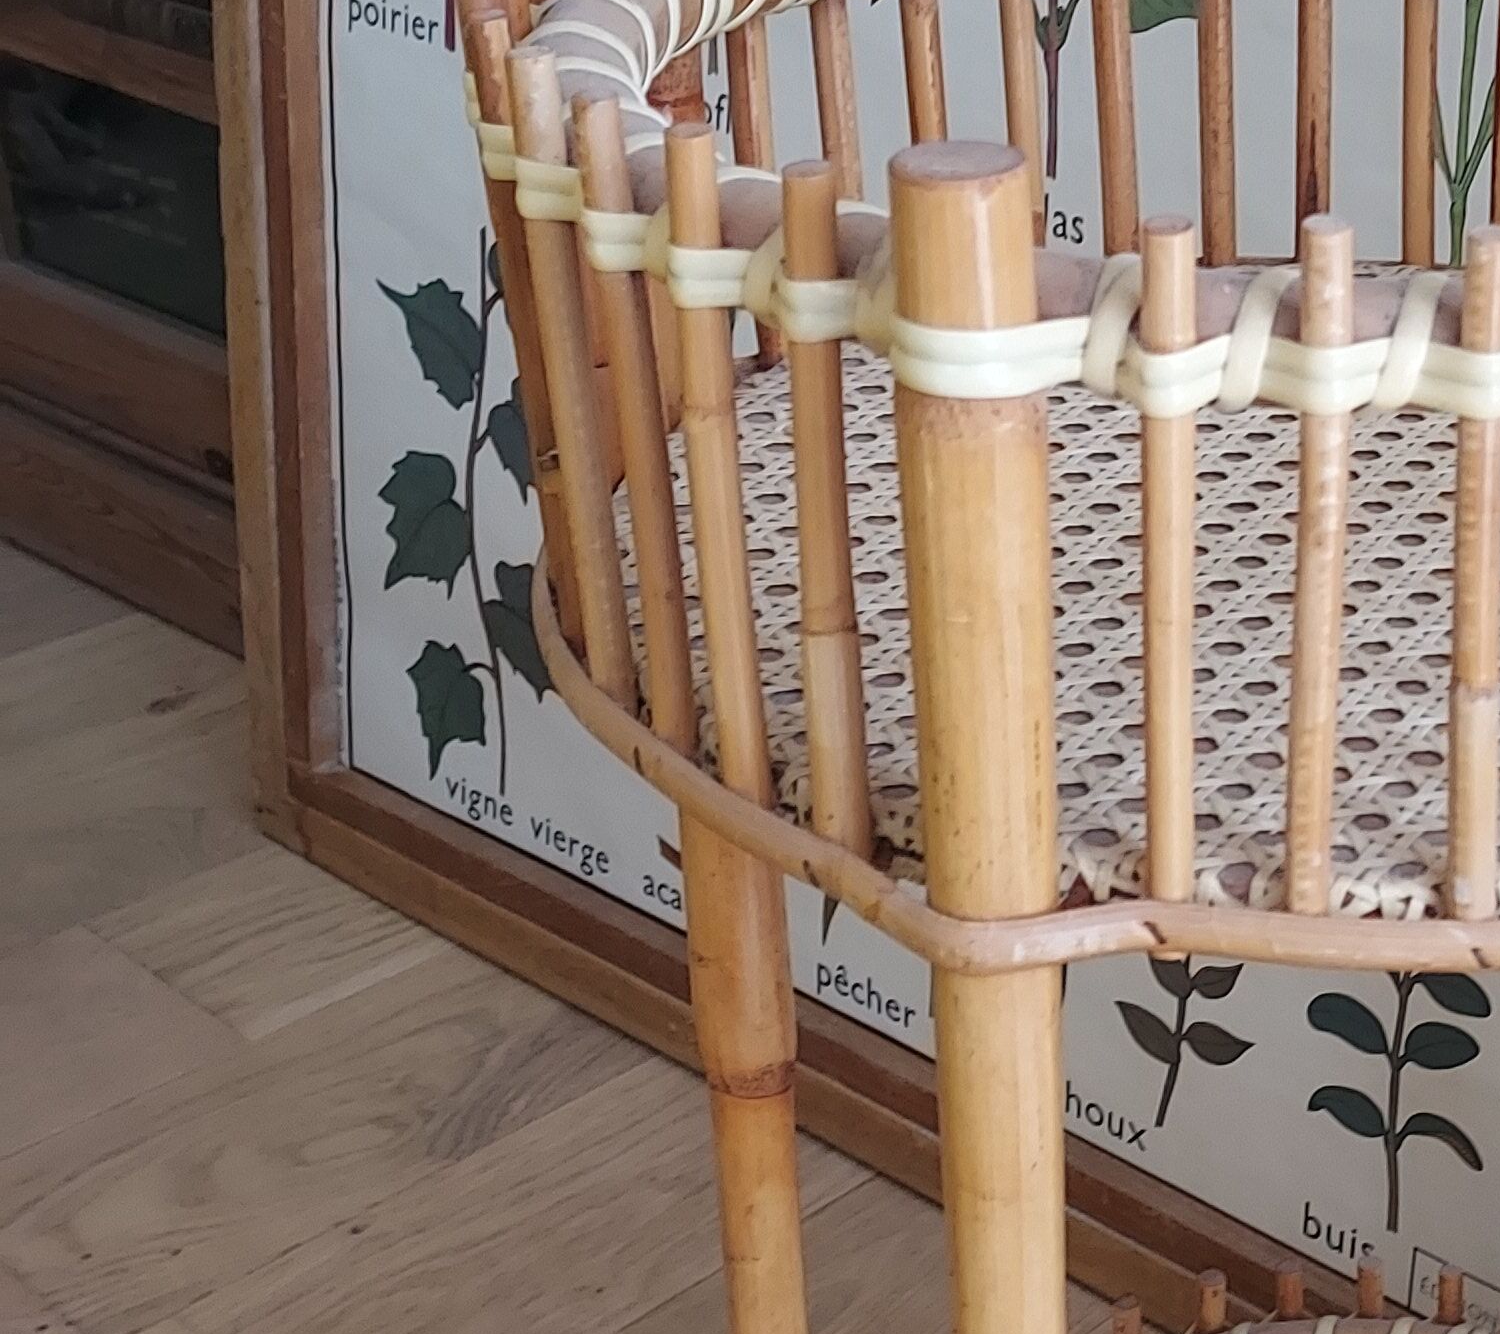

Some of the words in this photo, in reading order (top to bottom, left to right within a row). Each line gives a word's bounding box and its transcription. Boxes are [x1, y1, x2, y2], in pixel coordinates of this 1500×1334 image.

[445, 775, 514, 828] vigne
[529, 811, 610, 876] vierge
[815, 962, 917, 1028] pêcher
[1065, 1080, 1147, 1152] houx
[1301, 1200, 1376, 1261] buis
